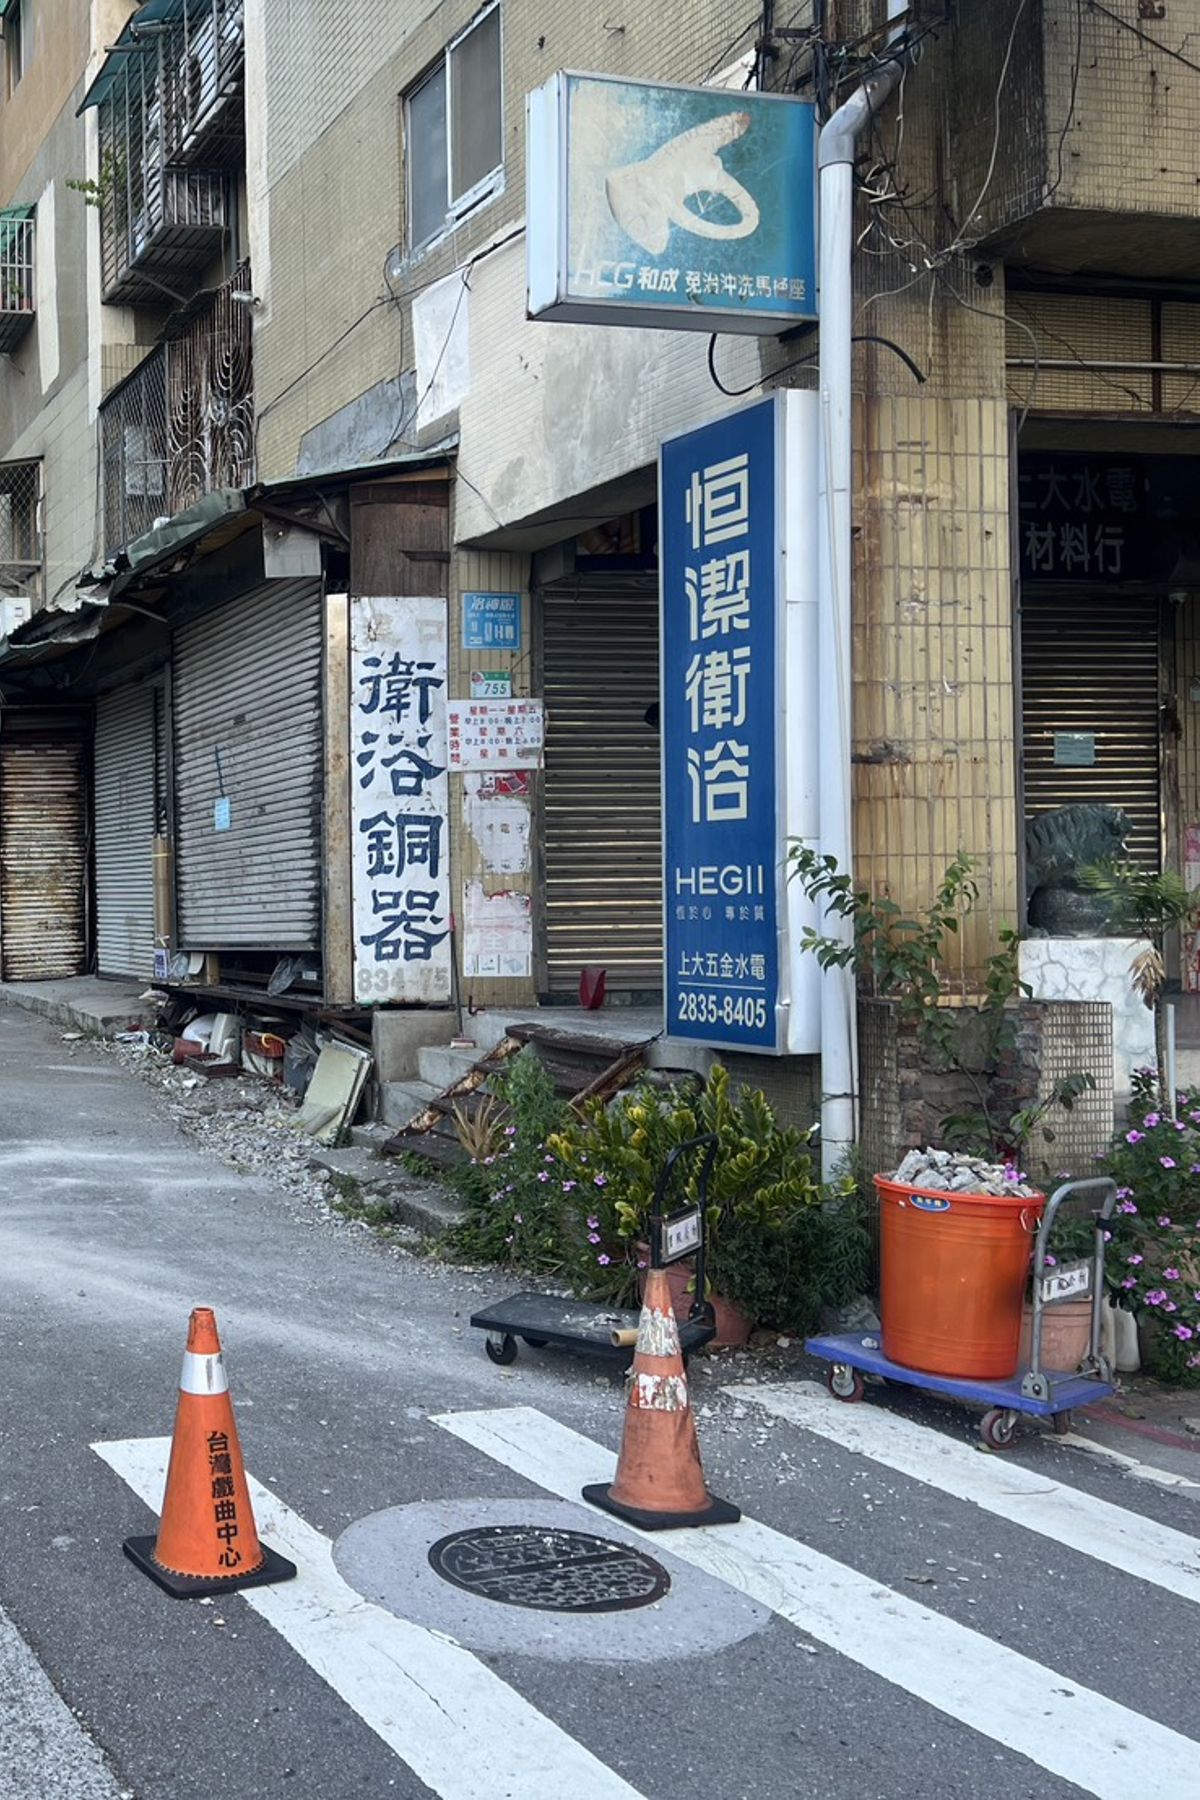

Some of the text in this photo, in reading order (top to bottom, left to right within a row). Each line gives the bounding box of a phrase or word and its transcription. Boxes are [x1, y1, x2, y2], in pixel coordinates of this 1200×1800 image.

[638, 265, 679, 293] 和成
[1025, 521, 1124, 574] 材料行
[685, 452, 751, 825] 恒潔衛浴
[483, 682, 507, 695] 755
[357, 650, 448, 962] 衛浴銅器
[676, 865, 763, 896] HEGII
[678, 951, 765, 980] 上大五金水電
[678, 991, 766, 1029] 2835-8405
[207, 1430, 241, 1568] 台灣戲曲中心
